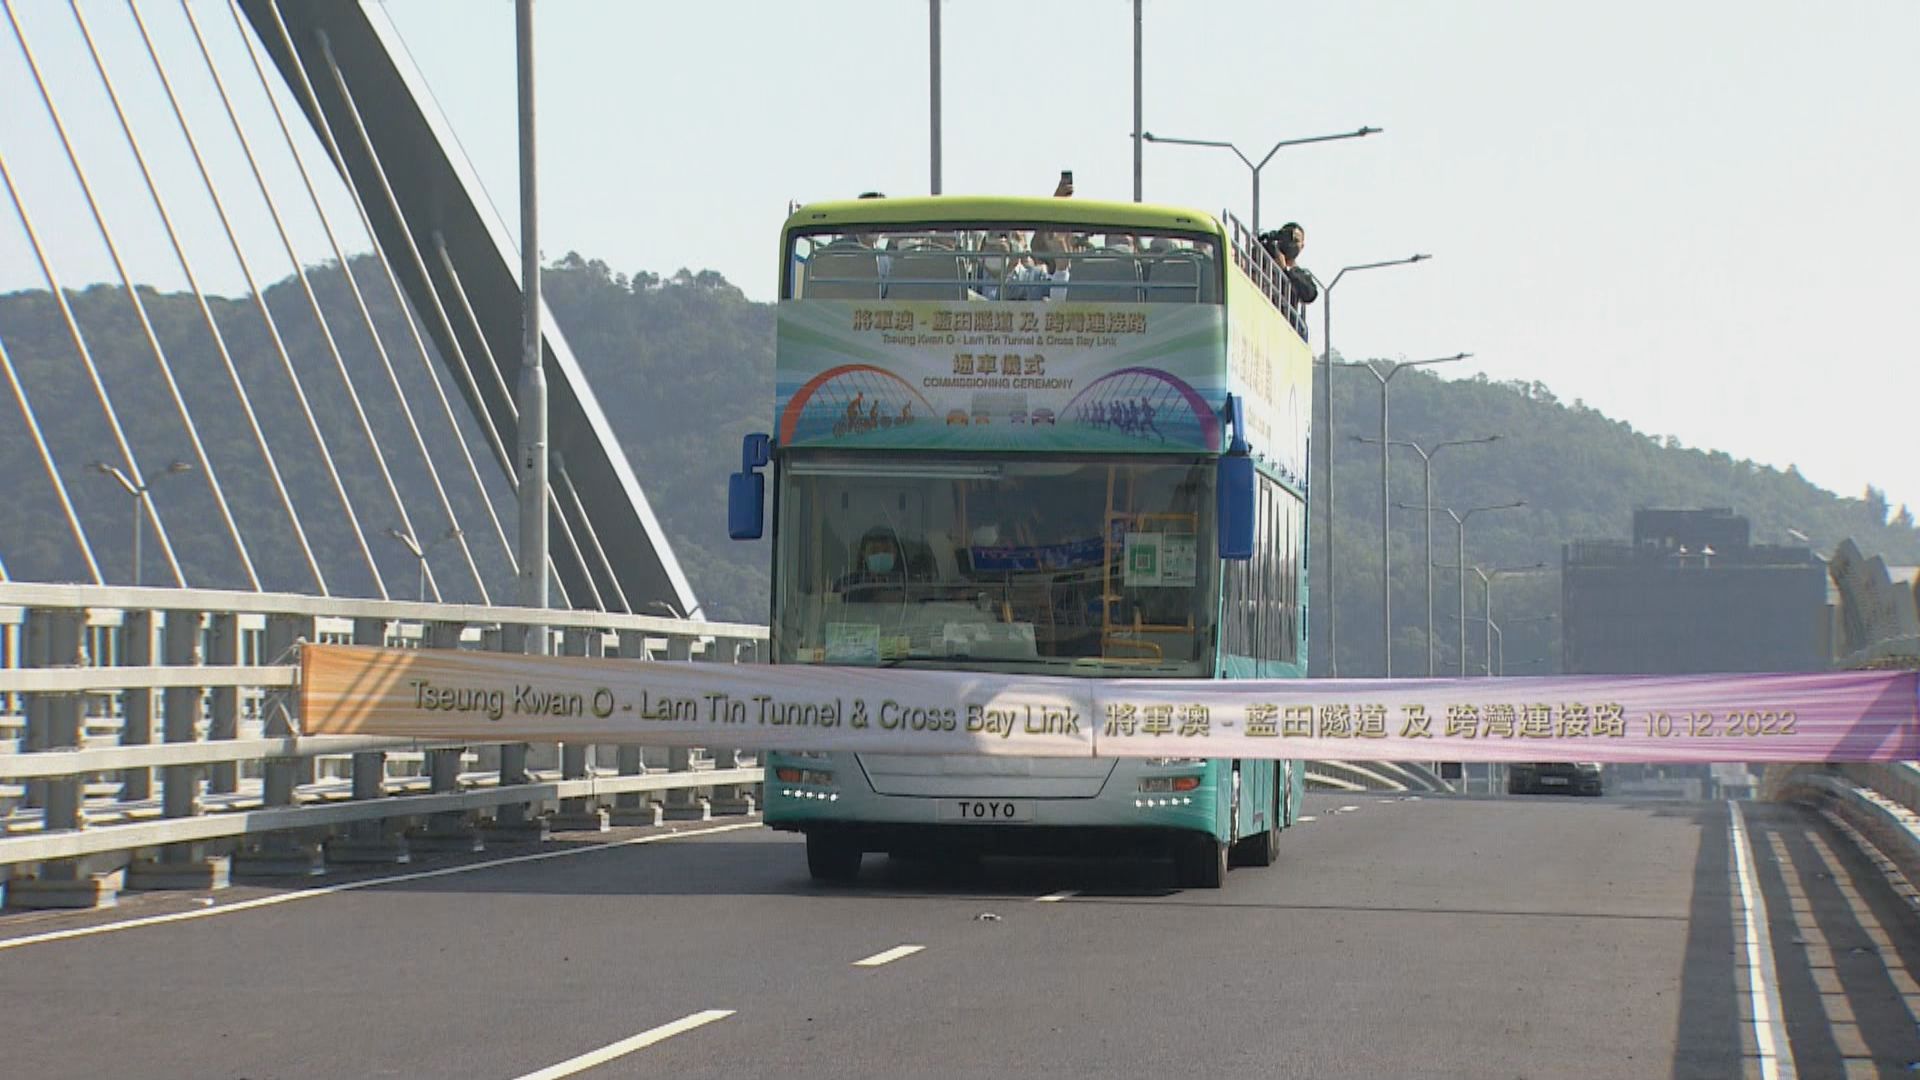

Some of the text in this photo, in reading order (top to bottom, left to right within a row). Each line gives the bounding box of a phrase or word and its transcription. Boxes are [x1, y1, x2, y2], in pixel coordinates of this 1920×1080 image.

[853, 311, 914, 331] 將軍澳
[932, 311, 1013, 332] 藍田隧道
[1020, 311, 1039, 333] 及
[1044, 311, 1147, 333] 跨灣連接路
[883, 334, 916, 346] Tseung
[918, 335, 944, 345] Kwan
[947, 335, 954, 345] O
[964, 336, 988, 345] Lam
[989, 335, 1002, 345] Tin
[1004, 335, 1035, 346] Tunnel
[1038, 335, 1044, 346] &
[1046, 336, 1074, 346] Cross
[1077, 336, 1095, 348] Bay
[1097, 336, 1117, 347] Link
[953, 354, 1046, 376] 通車儀式
[923, 377, 1073, 389] COMMISSIONING CEREMONY
[411, 679, 505, 720] Tseung
[511, 685, 583, 717] Kwan
[590, 687, 615, 719] O
[641, 690, 697, 721] Lam
[703, 693, 746, 723] Tin
[753, 695, 842, 728] Tunnel
[851, 698, 868, 730] &
[877, 699, 956, 732] Cross
[964, 703, 1017, 739] Bay
[1023, 705, 1080, 736] Link
[1103, 703, 1211, 737] 將軍澳
[1243, 703, 1388, 739] 藍田隧道
[1399, 705, 1433, 738] 及
[1444, 703, 1626, 739] 跨灣連接路
[1642, 710, 1798, 738] 10.12.2022
[958, 802, 1016, 818] TOYO
